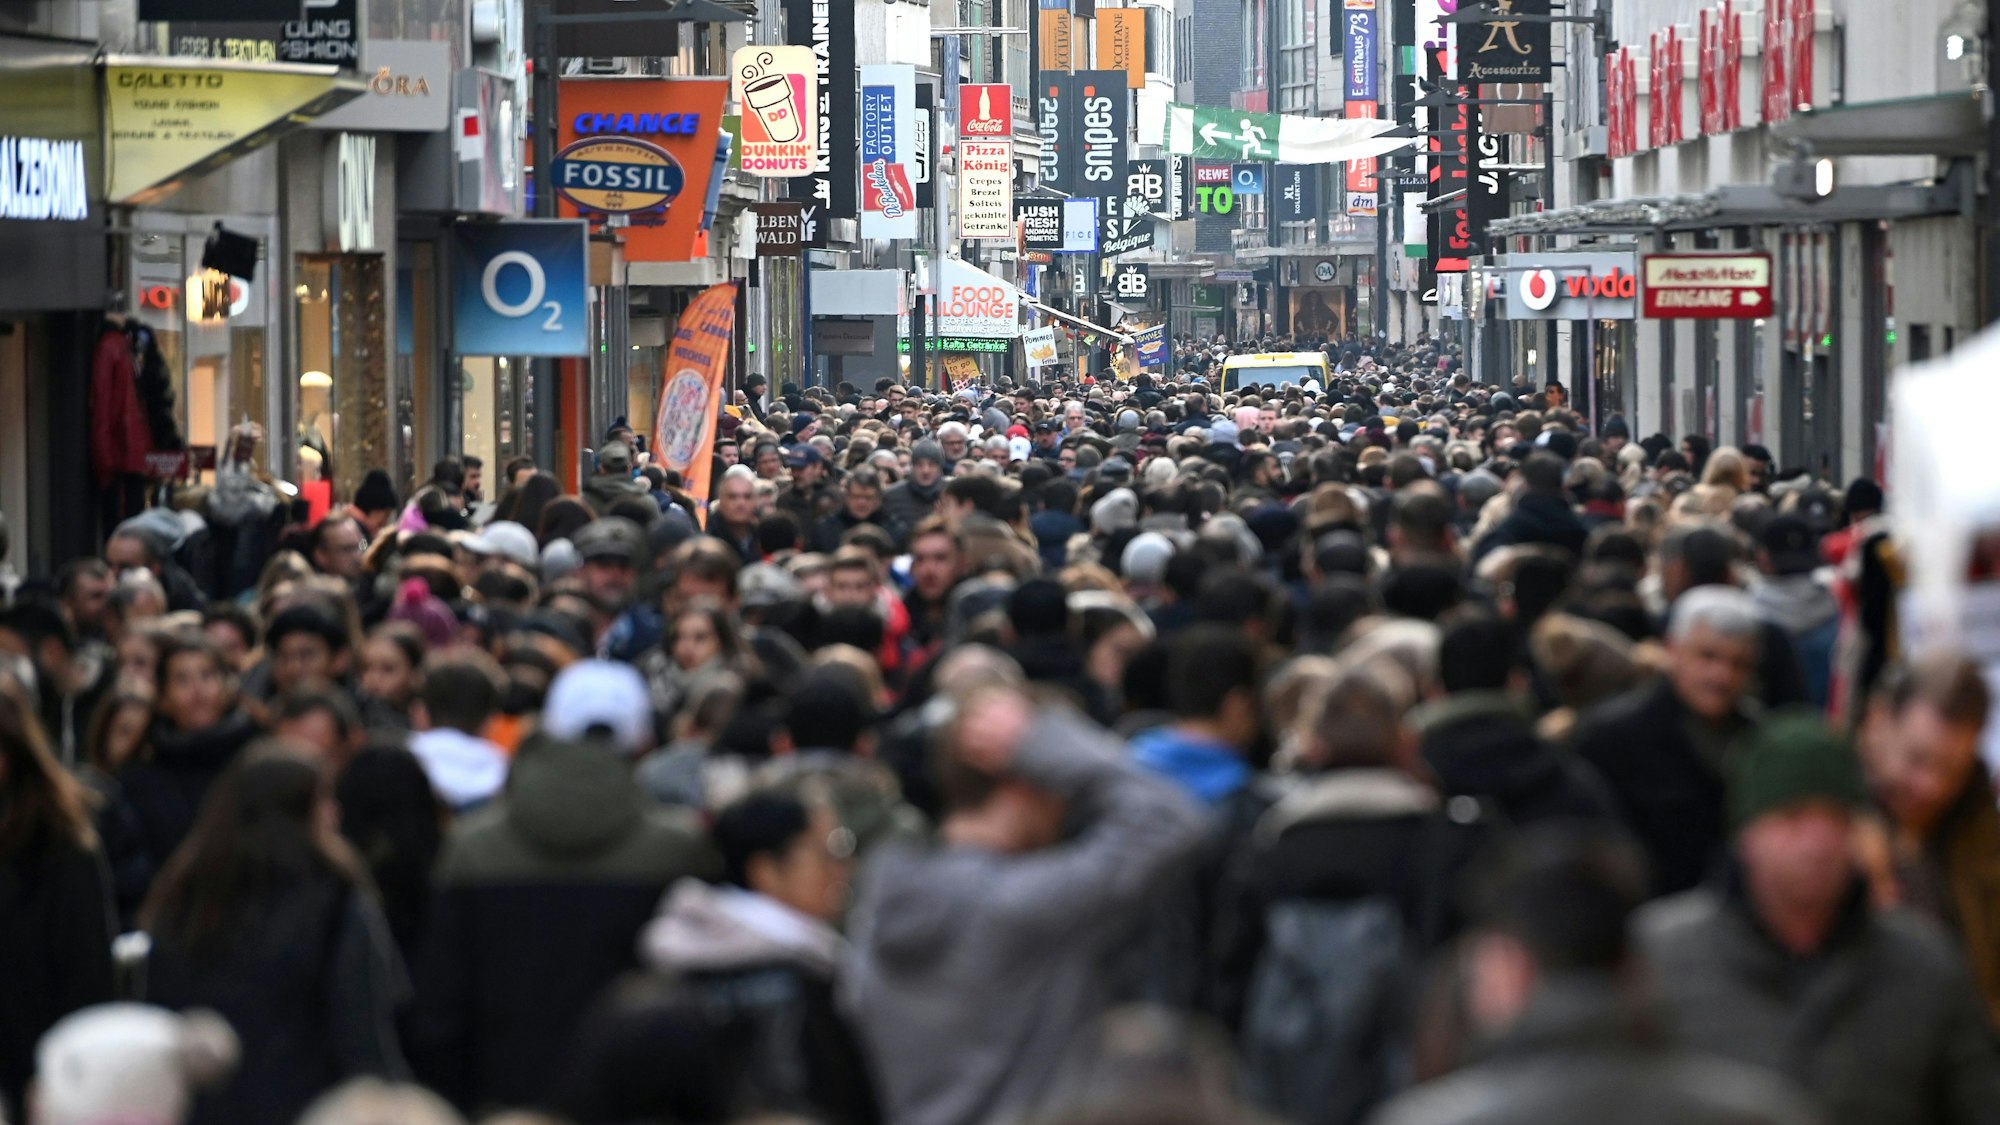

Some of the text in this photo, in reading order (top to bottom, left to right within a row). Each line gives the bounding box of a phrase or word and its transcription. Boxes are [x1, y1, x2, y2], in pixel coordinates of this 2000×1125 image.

[284, 19, 350, 38] OUNG
[280, 40, 357, 58] SHION
[812, 0, 830, 85] TRAINE
[1467, 60, 1542, 78] Accessorize
[574, 112, 700, 135] CHANGE
[768, 109, 787, 121] DD
[865, 94, 877, 154] FACTORY
[881, 94, 892, 154] OUTLET
[1084, 96, 1118, 181] snipes
[741, 145, 811, 156] DUNKIN'
[966, 145, 1005, 156] Pizza
[741, 158, 807, 170] DONUTS
[963, 159, 1008, 173] König
[564, 163, 671, 190] FOSSIL
[1198, 168, 1229, 180] REWE
[1196, 186, 1233, 214] TO
[1284, 184, 1294, 200] XL
[1352, 195, 1373, 207] dm
[1020, 206, 1059, 217] LUSH
[756, 215, 798, 228] LBEN
[1025, 218, 1059, 228] RESH
[1065, 231, 1092, 239] FICE
[1102, 233, 1151, 253] Belgique
[1565, 265, 1635, 297] voda
[952, 286, 1005, 302] FOOD
[1655, 289, 1734, 307] EINGANG
[943, 301, 1014, 318] LOUNGE
